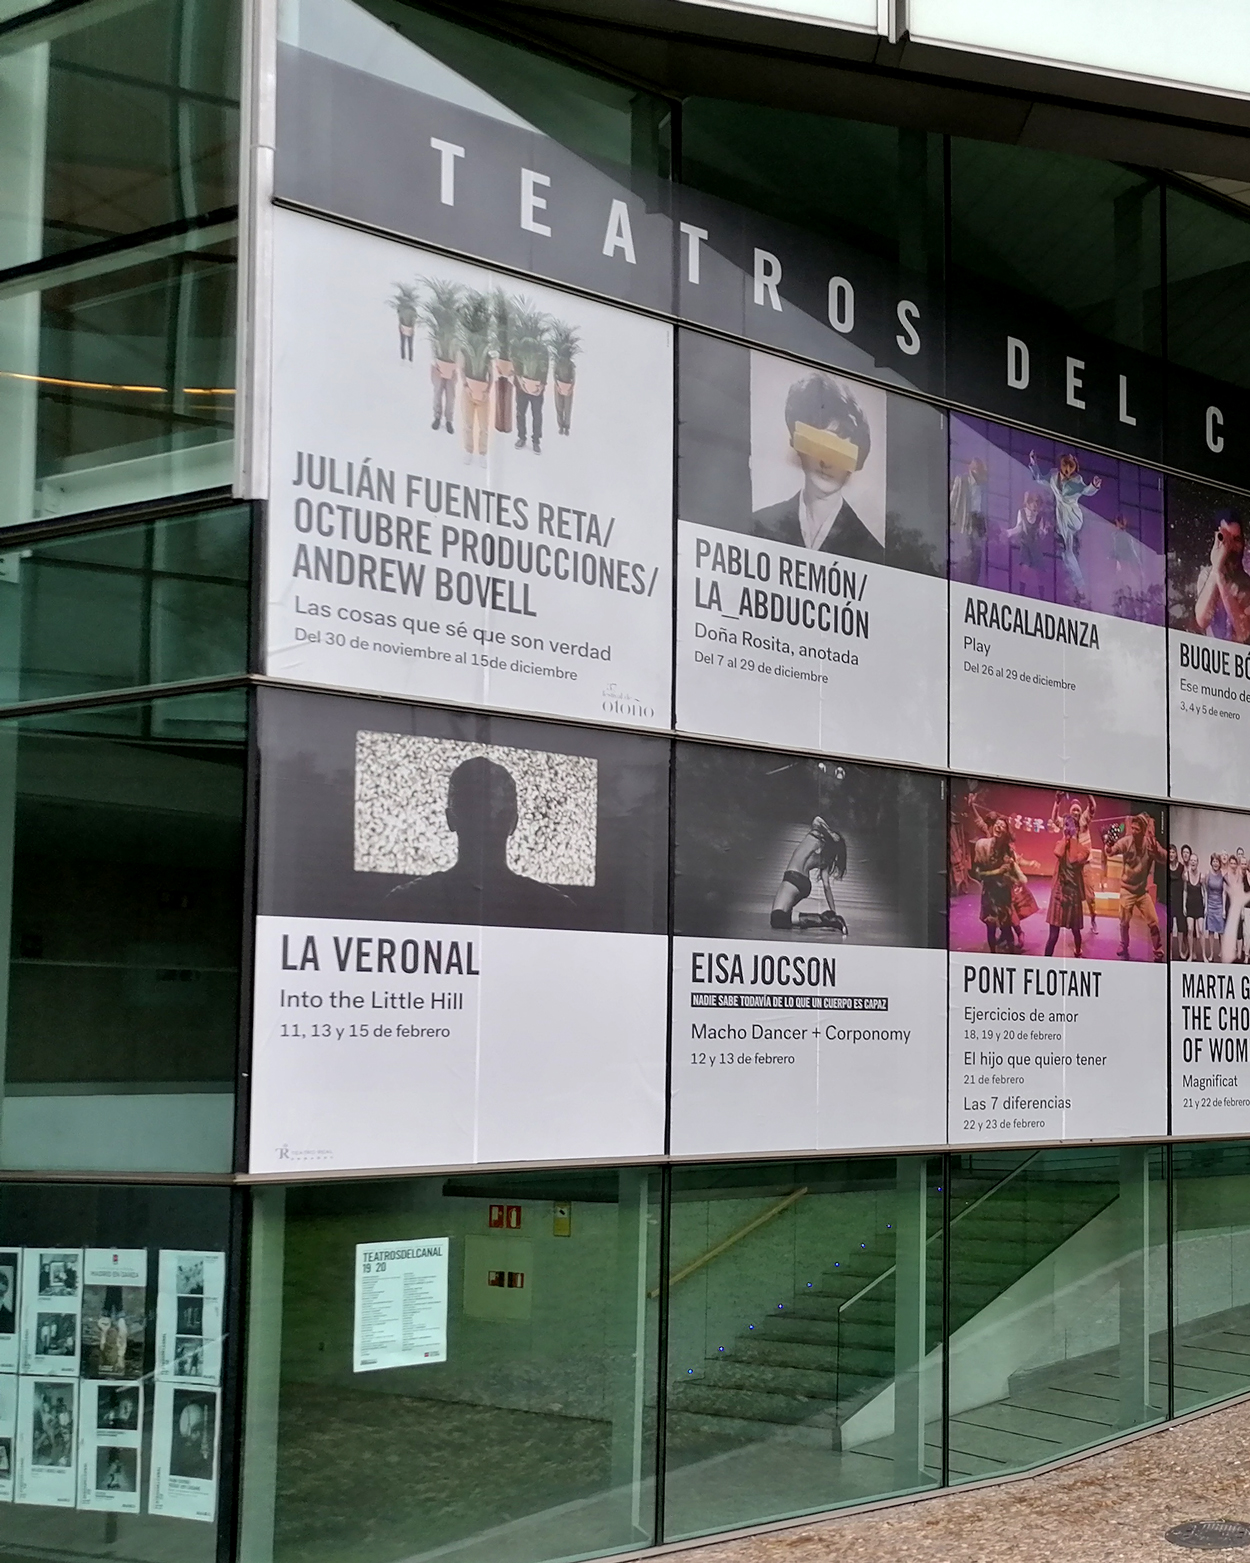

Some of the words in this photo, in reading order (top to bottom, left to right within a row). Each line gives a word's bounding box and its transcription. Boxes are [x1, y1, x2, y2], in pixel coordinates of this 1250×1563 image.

[430, 137, 921, 356] TEATROS
[1007, 335, 1137, 427] DEL
[292, 450, 396, 505] JULIÁN
[406, 473, 529, 531] FUENTES
[538, 501, 616, 548] RETA/
[294, 497, 433, 556] OCTUBRE
[442, 524, 659, 598] PRODUCCIONES/
[292, 542, 426, 598] ANDREW
[436, 567, 537, 618] BOVELL
[695, 537, 771, 583] PABLO
[779, 556, 868, 602] REMÓN/
[695, 577, 870, 640] LA_ABDUCCIÓN
[964, 597, 1100, 650] ARACALADANZA
[295, 595, 331, 619] Las
[337, 605, 397, 629] cosas
[402, 614, 441, 638] que
[446, 619, 468, 639] sé
[473, 626, 506, 647] que
[511, 633, 544, 651] son
[549, 637, 612, 663] verdad
[695, 621, 738, 645] Doña
[742, 631, 795, 657] Rosita,
[799, 645, 860, 666] anotada
[295, 627, 321, 644] Del
[325, 630, 346, 647] 30
[350, 633, 370, 651] de
[373, 640, 451, 663] noviembre
[455, 648, 467, 665] al
[510, 656, 578, 682] diciembre
[964, 636, 991, 657] Play
[1180, 642, 1231, 676] BUQUE
[695, 650, 714, 666] Del
[717, 654, 725, 666] 7
[727, 656, 738, 669] al
[740, 658, 755, 672] 29
[757, 661, 772, 675] de
[774, 665, 829, 684] diciembre
[1180, 678, 1199, 694] Ese
[1201, 683, 1237, 701] mundo
[281, 934, 320, 972] LA
[333, 935, 480, 976] VERONAL
[691, 952, 745, 985] EISA
[750, 955, 836, 987] JOCSON
[964, 965, 1017, 995] PONT
[1024, 968, 1102, 997] FLOTANT
[1182, 973, 1236, 999] MARTA
[280, 989, 323, 1009] Into
[329, 990, 364, 1009] the
[371, 991, 425, 1010] Little
[431, 992, 463, 1010] Hill
[692, 994, 717, 1006] NADIE
[718, 995, 739, 1007] SABE
[740, 994, 772, 1008] TODAVÍA
[773, 996, 784, 1008] DE
[784, 996, 794, 1008] LO
[796, 997, 811, 1009] QUE
[812, 997, 822, 1009] UN
[823, 998, 852, 1009] CUERPO
[853, 998, 863, 1009] ES
[864, 999, 887, 1010] CAPAZ
[964, 1006, 1026, 1024] Ejercicios
[1029, 1008, 1045, 1022] de
[1048, 1011, 1079, 1023] amor
[691, 1023, 747, 1040] Macho
[751, 1023, 808, 1041] Dancer
[811, 1028, 821, 1038] +
[825, 1025, 911, 1045] Corponomy
[1182, 1006, 1212, 1030] THE
[964, 1051, 976, 1065] El
[980, 1052, 1003, 1069] hijo
[1007, 1056, 1031, 1069] que
[1034, 1052, 1072, 1069] quiero
[1076, 1053, 1107, 1066] tener
[1183, 1038, 1203, 1063] OF
[1182, 1074, 1238, 1091] Magnificat
[964, 1096, 986, 1111] Las
[991, 1097, 999, 1110] 7
[1003, 1095, 1071, 1110] diferencias
[363, 1247, 443, 1262] TEATROSDELCANAL
[363, 1263, 372, 1273] 19
[375, 1262, 387, 1272] 20
